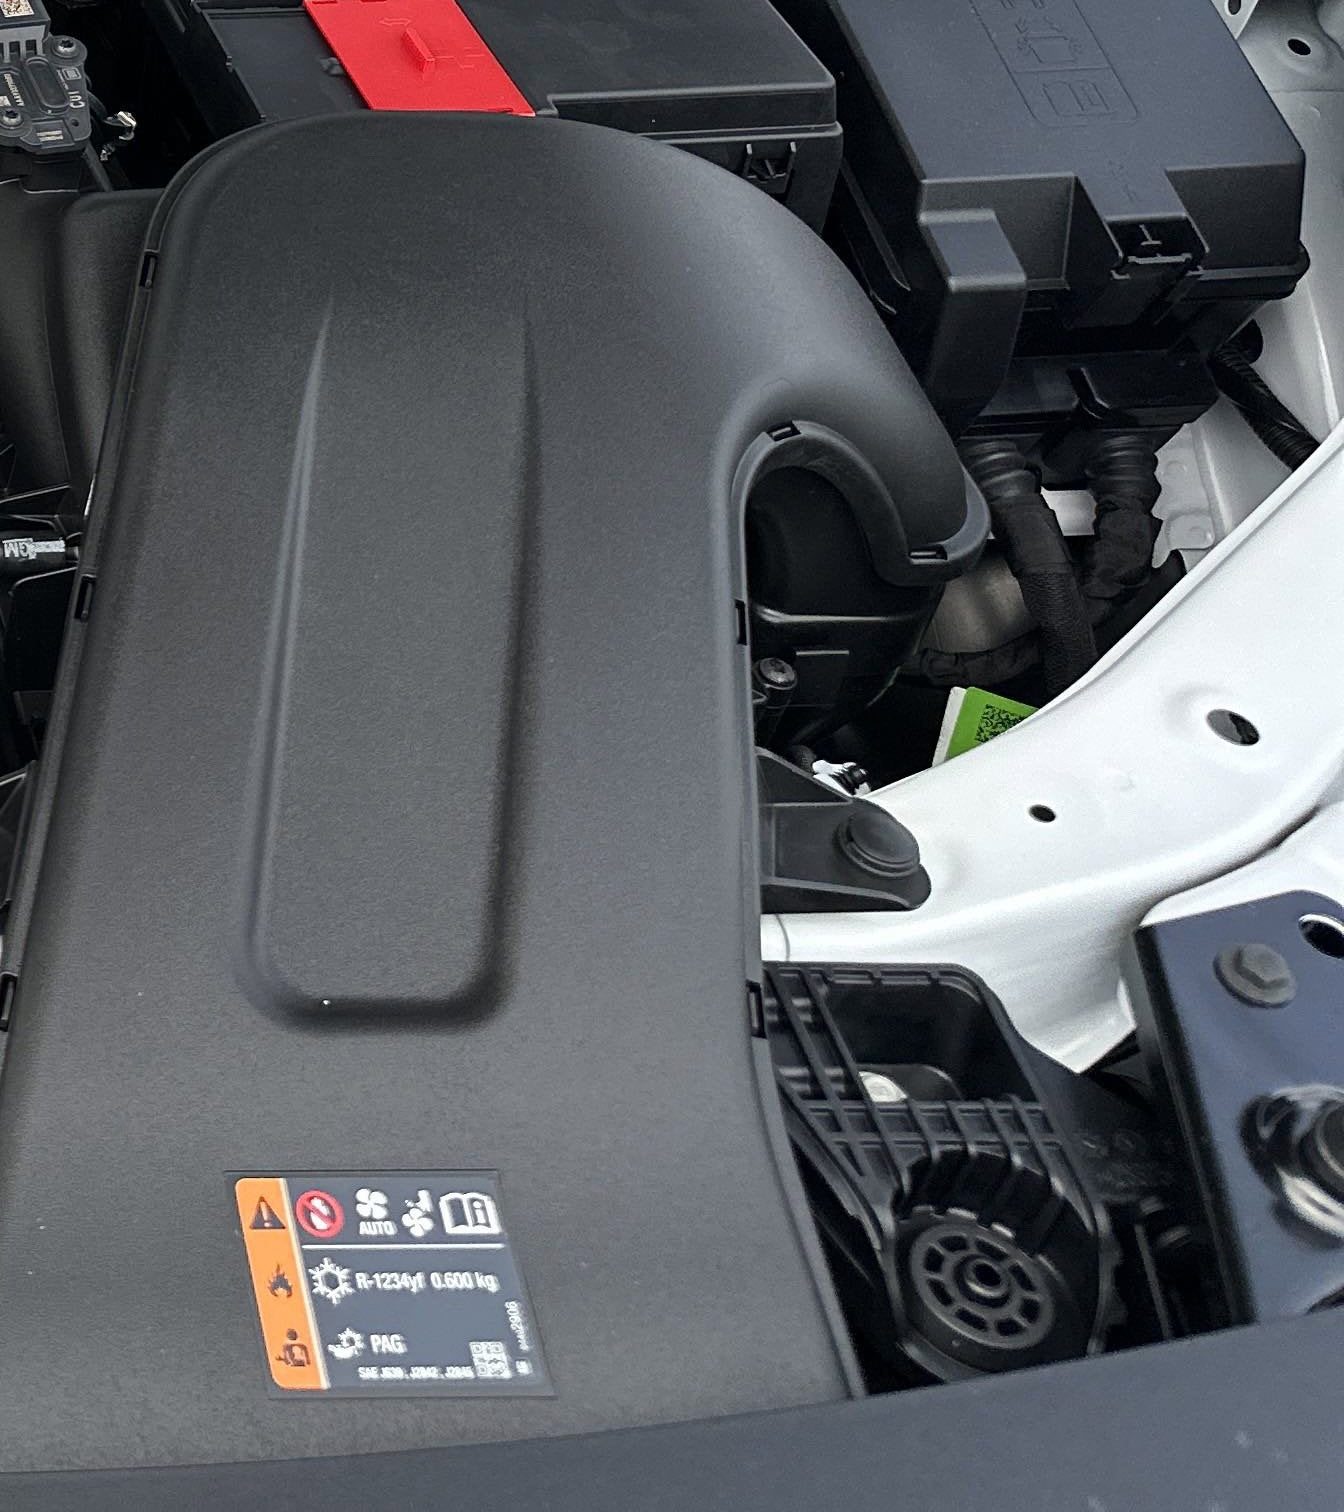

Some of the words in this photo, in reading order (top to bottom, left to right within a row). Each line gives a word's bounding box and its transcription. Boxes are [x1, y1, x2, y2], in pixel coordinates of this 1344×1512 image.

[3, 538, 32, 558] GM
[359, 1221, 397, 1235] AUTO
[355, 1272, 426, 1294] R-1234yf
[430, 1272, 474, 1290] 0.600
[476, 1272, 501, 1293] kg
[370, 1334, 407, 1354] PAG
[358, 1366, 379, 1379] SAE
